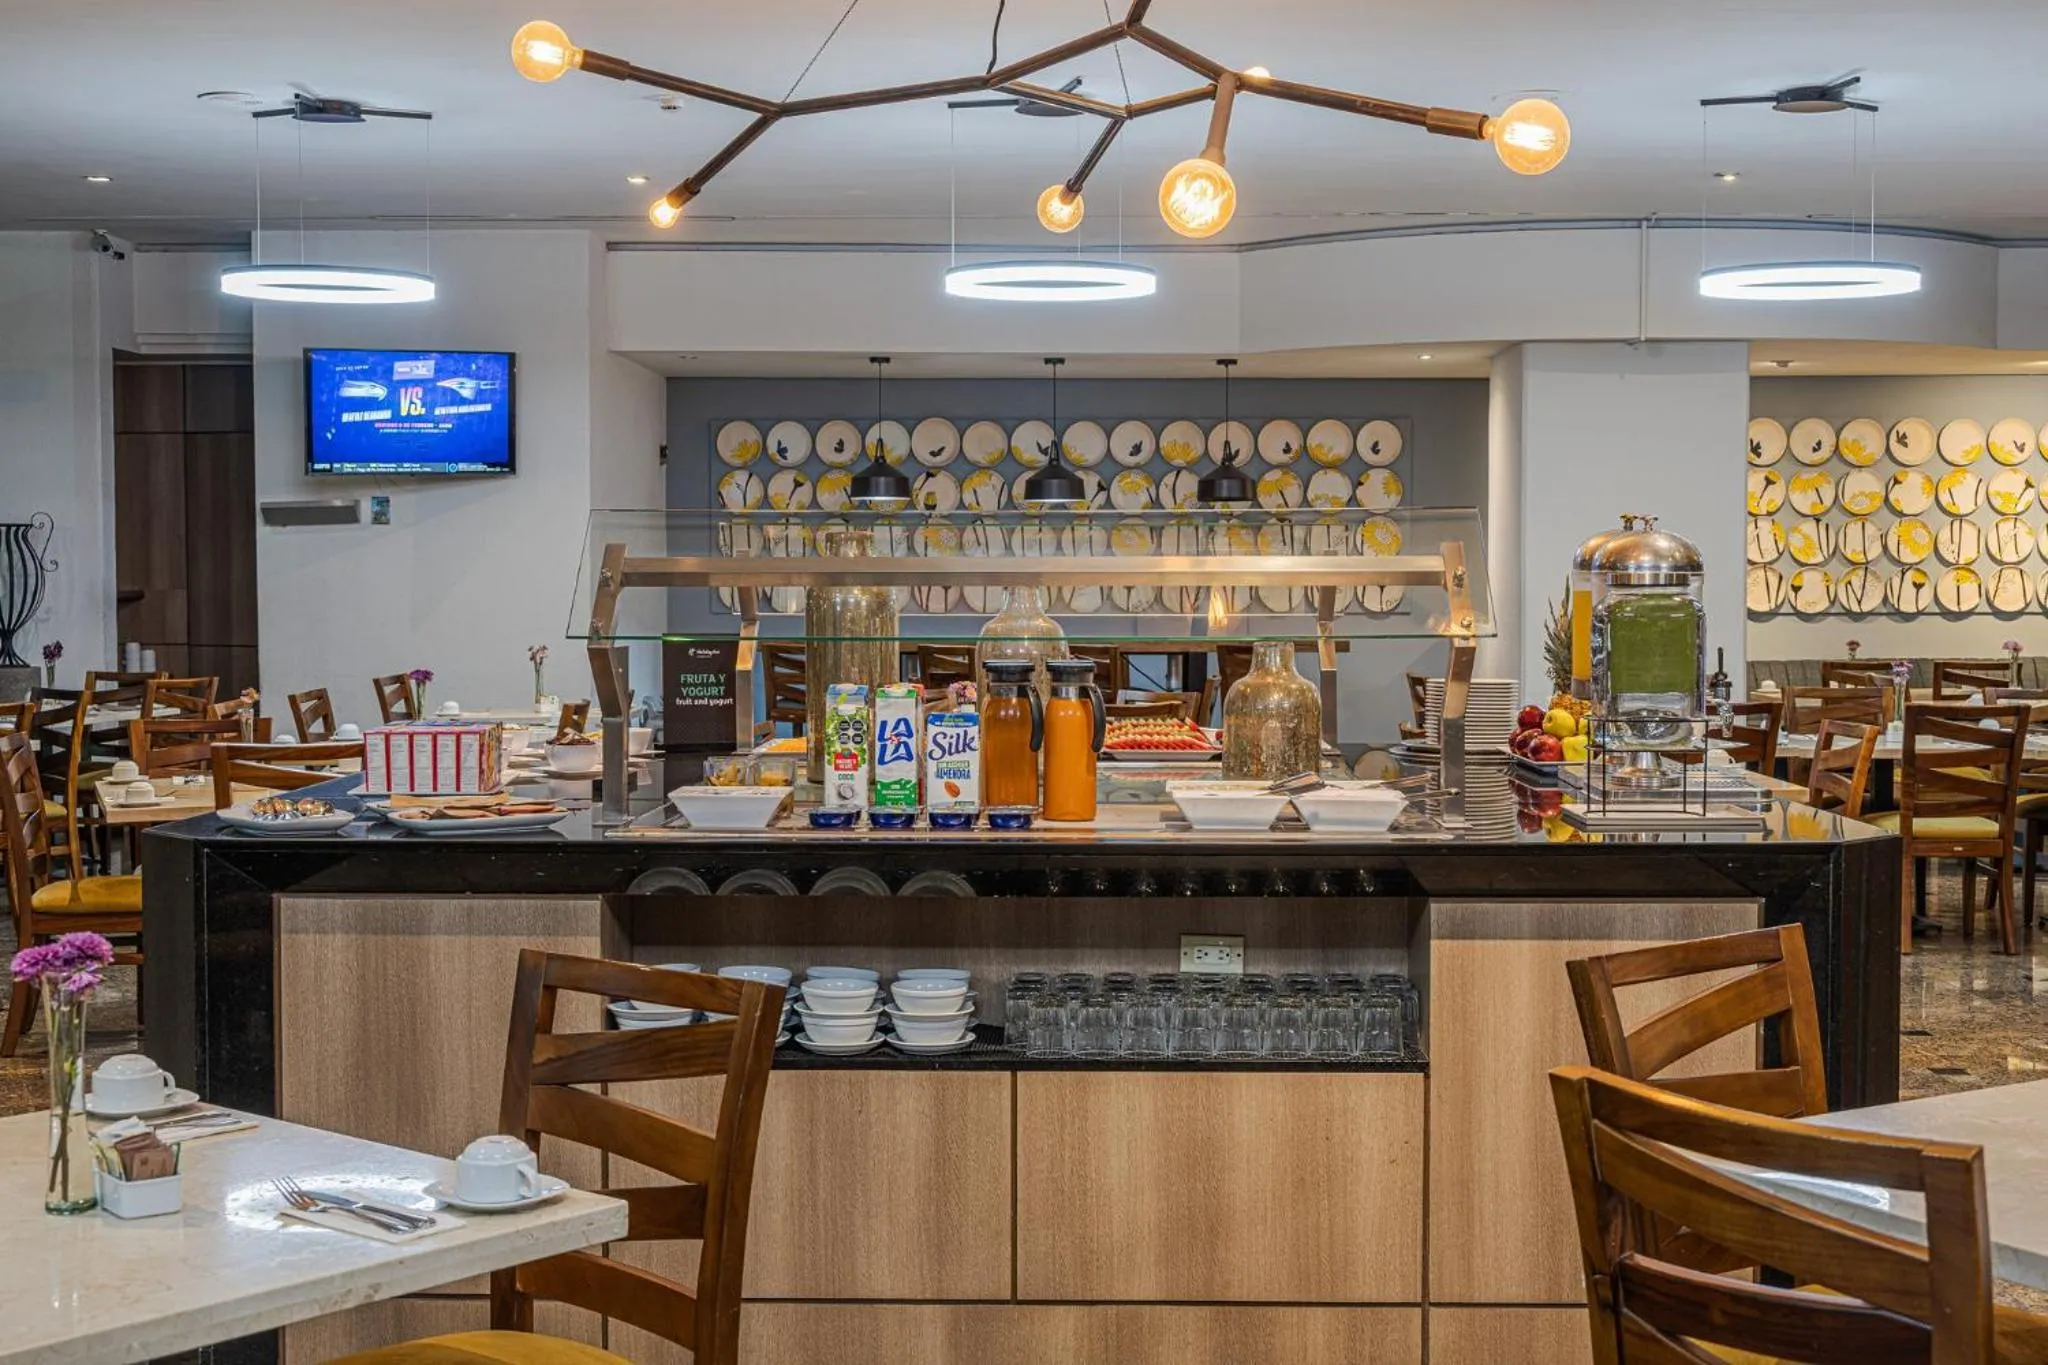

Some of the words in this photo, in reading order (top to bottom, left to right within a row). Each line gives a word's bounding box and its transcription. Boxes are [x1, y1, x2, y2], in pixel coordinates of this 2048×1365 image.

[400, 386, 426, 416] VS.
[680, 673, 717, 684] FRUTA
[718, 673, 726, 684] Y
[675, 697, 692, 705] fruit
[694, 697, 708, 705] and
[709, 698, 734, 707] yogurt
[681, 686, 726, 696] YOGURT
[877, 717, 914, 741] LA
[877, 741, 914, 766] LA
[928, 729, 979, 761] Silk
